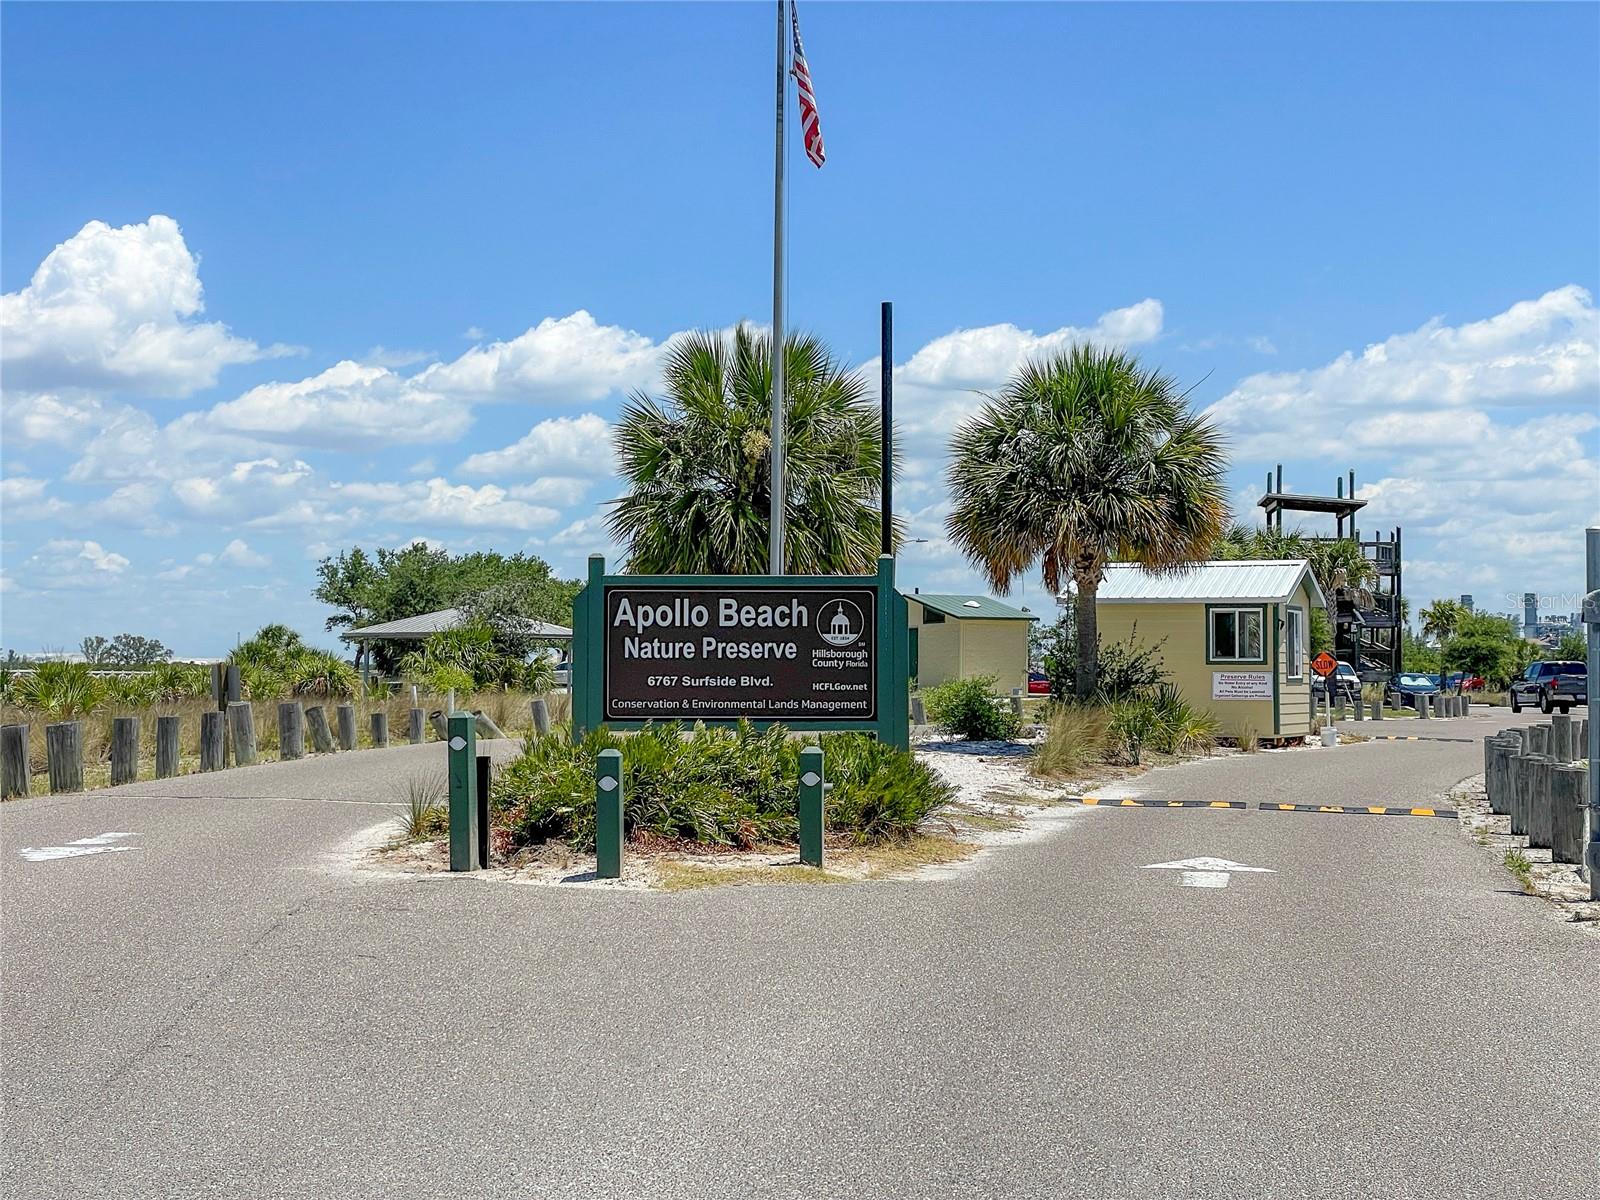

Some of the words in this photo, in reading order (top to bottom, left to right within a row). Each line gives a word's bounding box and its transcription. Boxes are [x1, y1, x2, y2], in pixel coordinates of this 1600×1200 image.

[613, 598, 709, 634] Apollo
[718, 598, 809, 628] Beach
[624, 637, 696, 660] Nature
[702, 637, 798, 660] Preserve
[812, 649, 868, 660] Hillsborough
[812, 659, 844, 669] County
[1315, 659, 1334, 670] SLOW
[647, 675, 678, 687] 6767
[681, 674, 737, 687] Surfside
[740, 675, 774, 687] Blvd.
[812, 682, 868, 691] HCFLGov.net
[612, 699, 680, 710] Conservation
[681, 699, 690, 710] &
[692, 699, 766, 710] Environmental
[768, 699, 799, 710] Lands
[801, 699, 868, 712] Management
